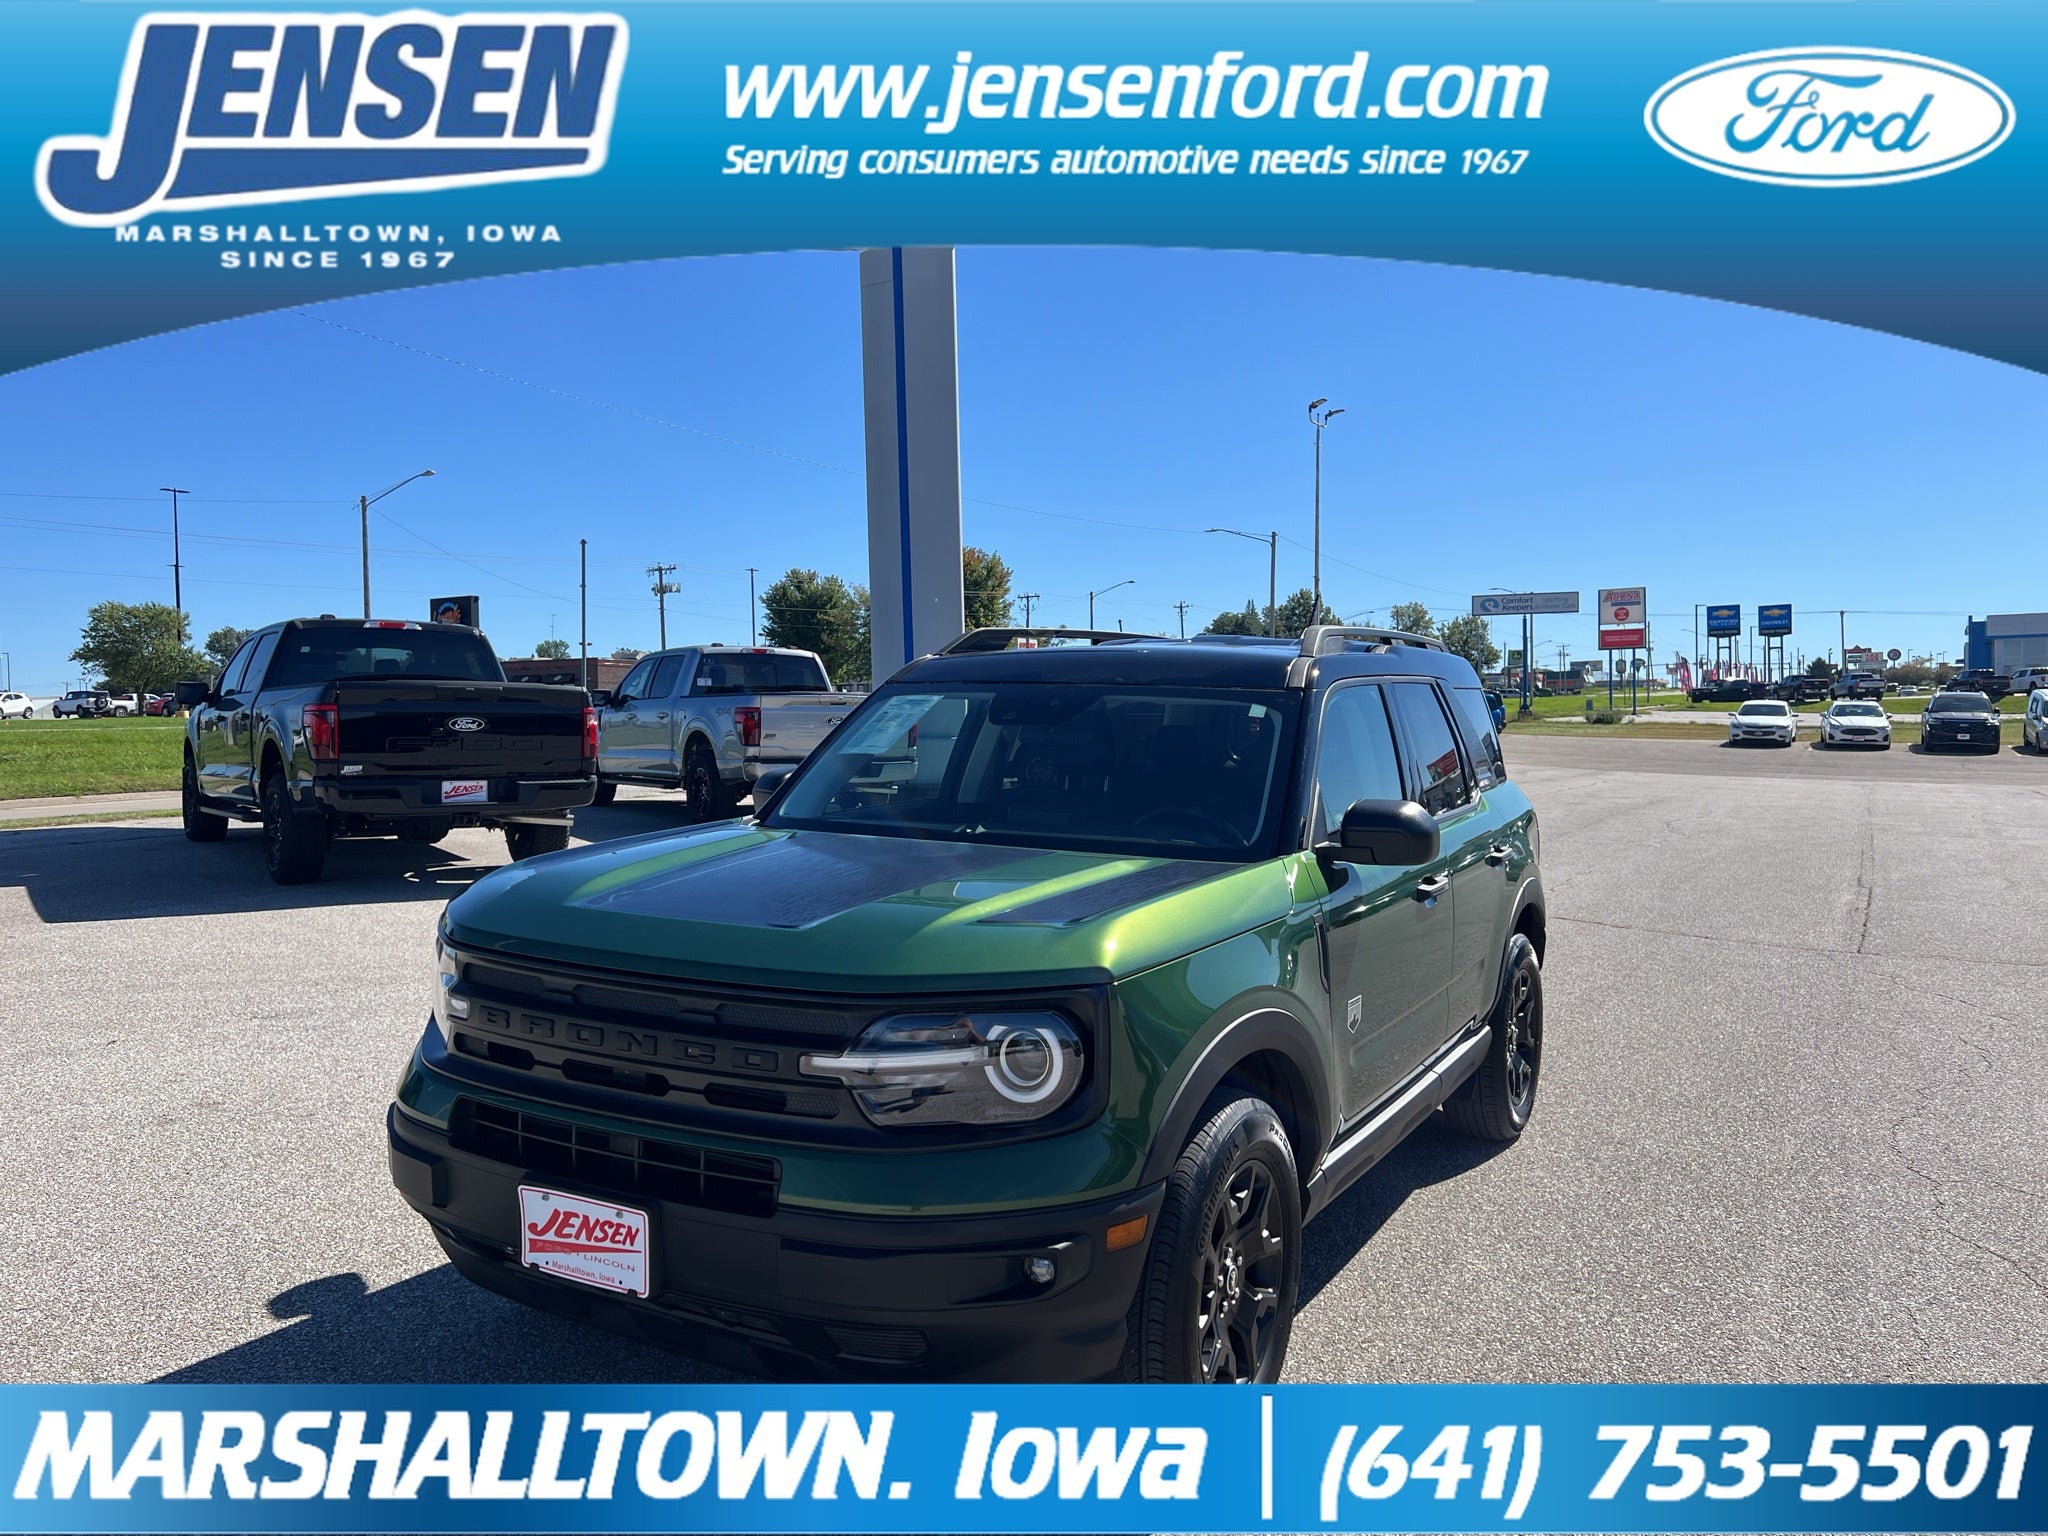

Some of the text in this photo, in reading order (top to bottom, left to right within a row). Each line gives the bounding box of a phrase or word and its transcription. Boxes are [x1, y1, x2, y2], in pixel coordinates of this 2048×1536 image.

[1501, 597, 1534, 605] Comfort
[1604, 591, 1641, 602] ARONA
[454, 719, 479, 730] Ford
[445, 785, 485, 795] JENSEN
[480, 1004, 778, 1073] BRONCO
[527, 1208, 640, 1247] JENSEN
[584, 1254, 636, 1273] LINCOLN
[551, 1259, 616, 1284] Marshalltown, Iowa
